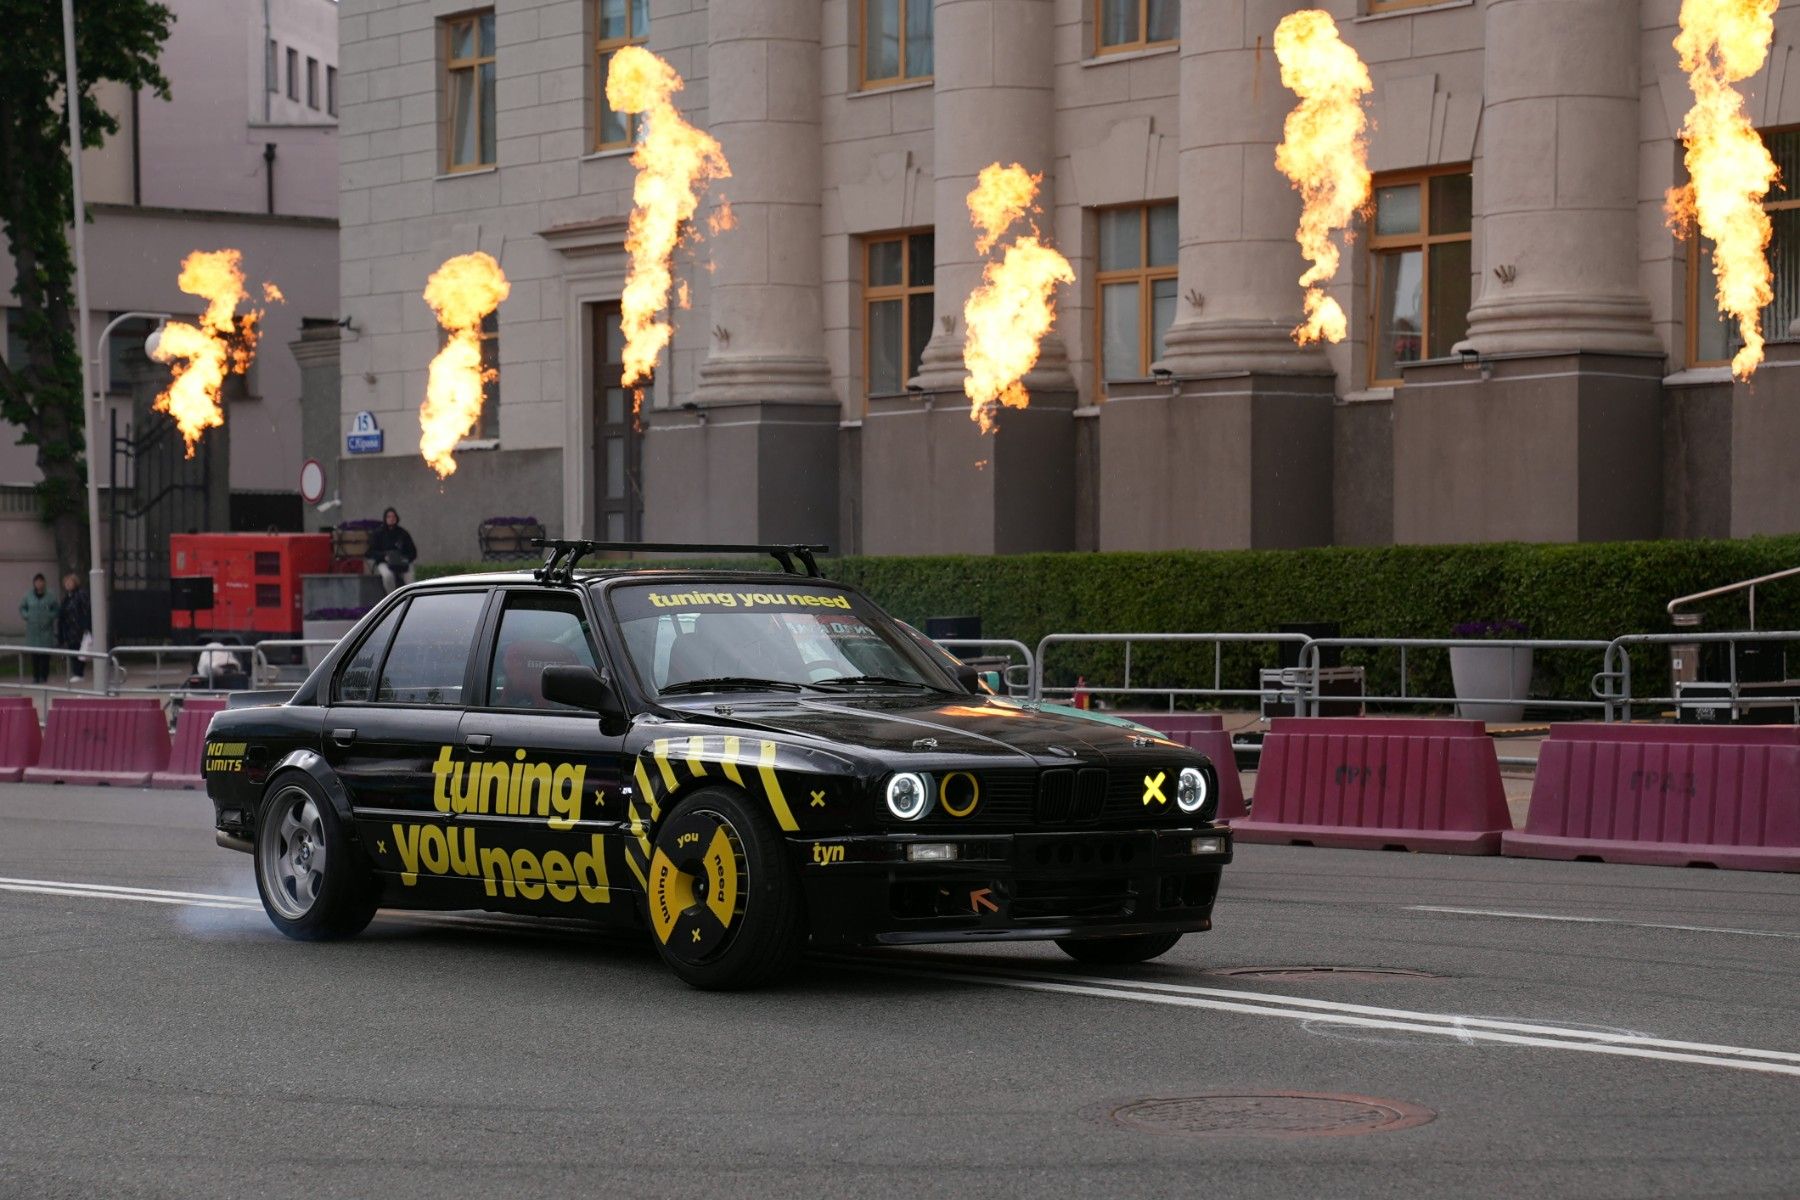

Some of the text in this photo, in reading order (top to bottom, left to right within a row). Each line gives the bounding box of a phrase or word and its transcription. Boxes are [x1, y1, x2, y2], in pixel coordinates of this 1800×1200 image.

[358, 415, 368, 431] 15
[648, 591, 851, 609] tuning you need
[207, 742, 223, 756] NO
[206, 759, 243, 771] LIMITS
[432, 746, 587, 830] tuning
[677, 832, 699, 849] you
[392, 824, 611, 903] you need
[813, 842, 845, 866] tyn
[714, 854, 725, 903] need
[658, 865, 671, 924] tuning
